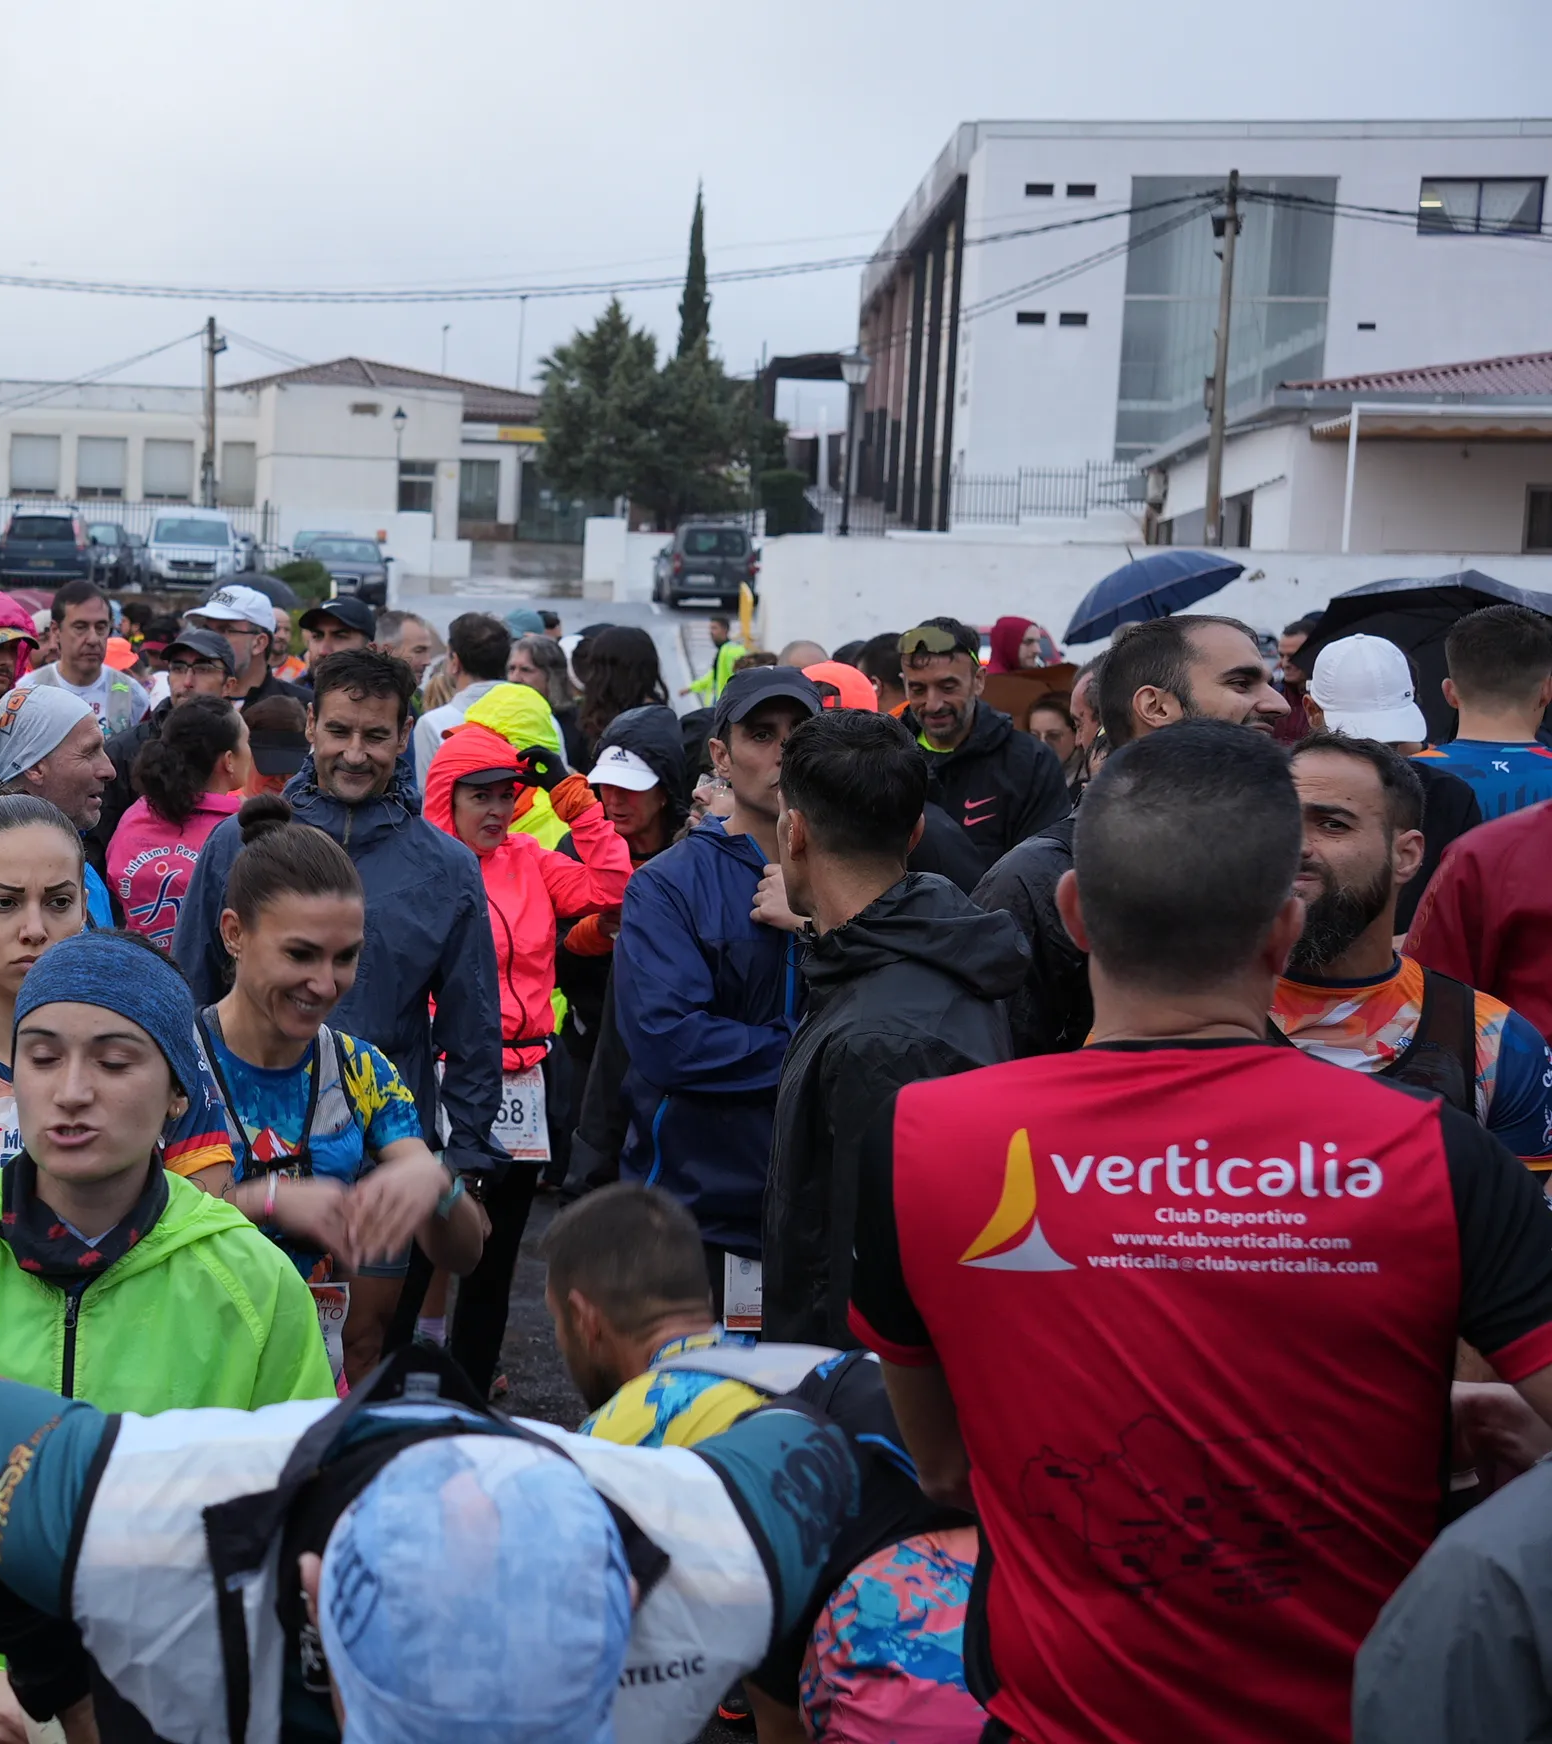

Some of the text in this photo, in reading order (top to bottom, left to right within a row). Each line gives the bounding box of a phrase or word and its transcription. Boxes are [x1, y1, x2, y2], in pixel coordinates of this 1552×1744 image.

[124, 846, 170, 878] Atletismo
[1049, 1138, 1384, 1198] verticalia
[1154, 1206, 1308, 1228] Club Deportivo
[1112, 1230, 1352, 1250] www.clubverticalia.com
[1086, 1252, 1379, 1274] verticalia@clubverticalia.com
